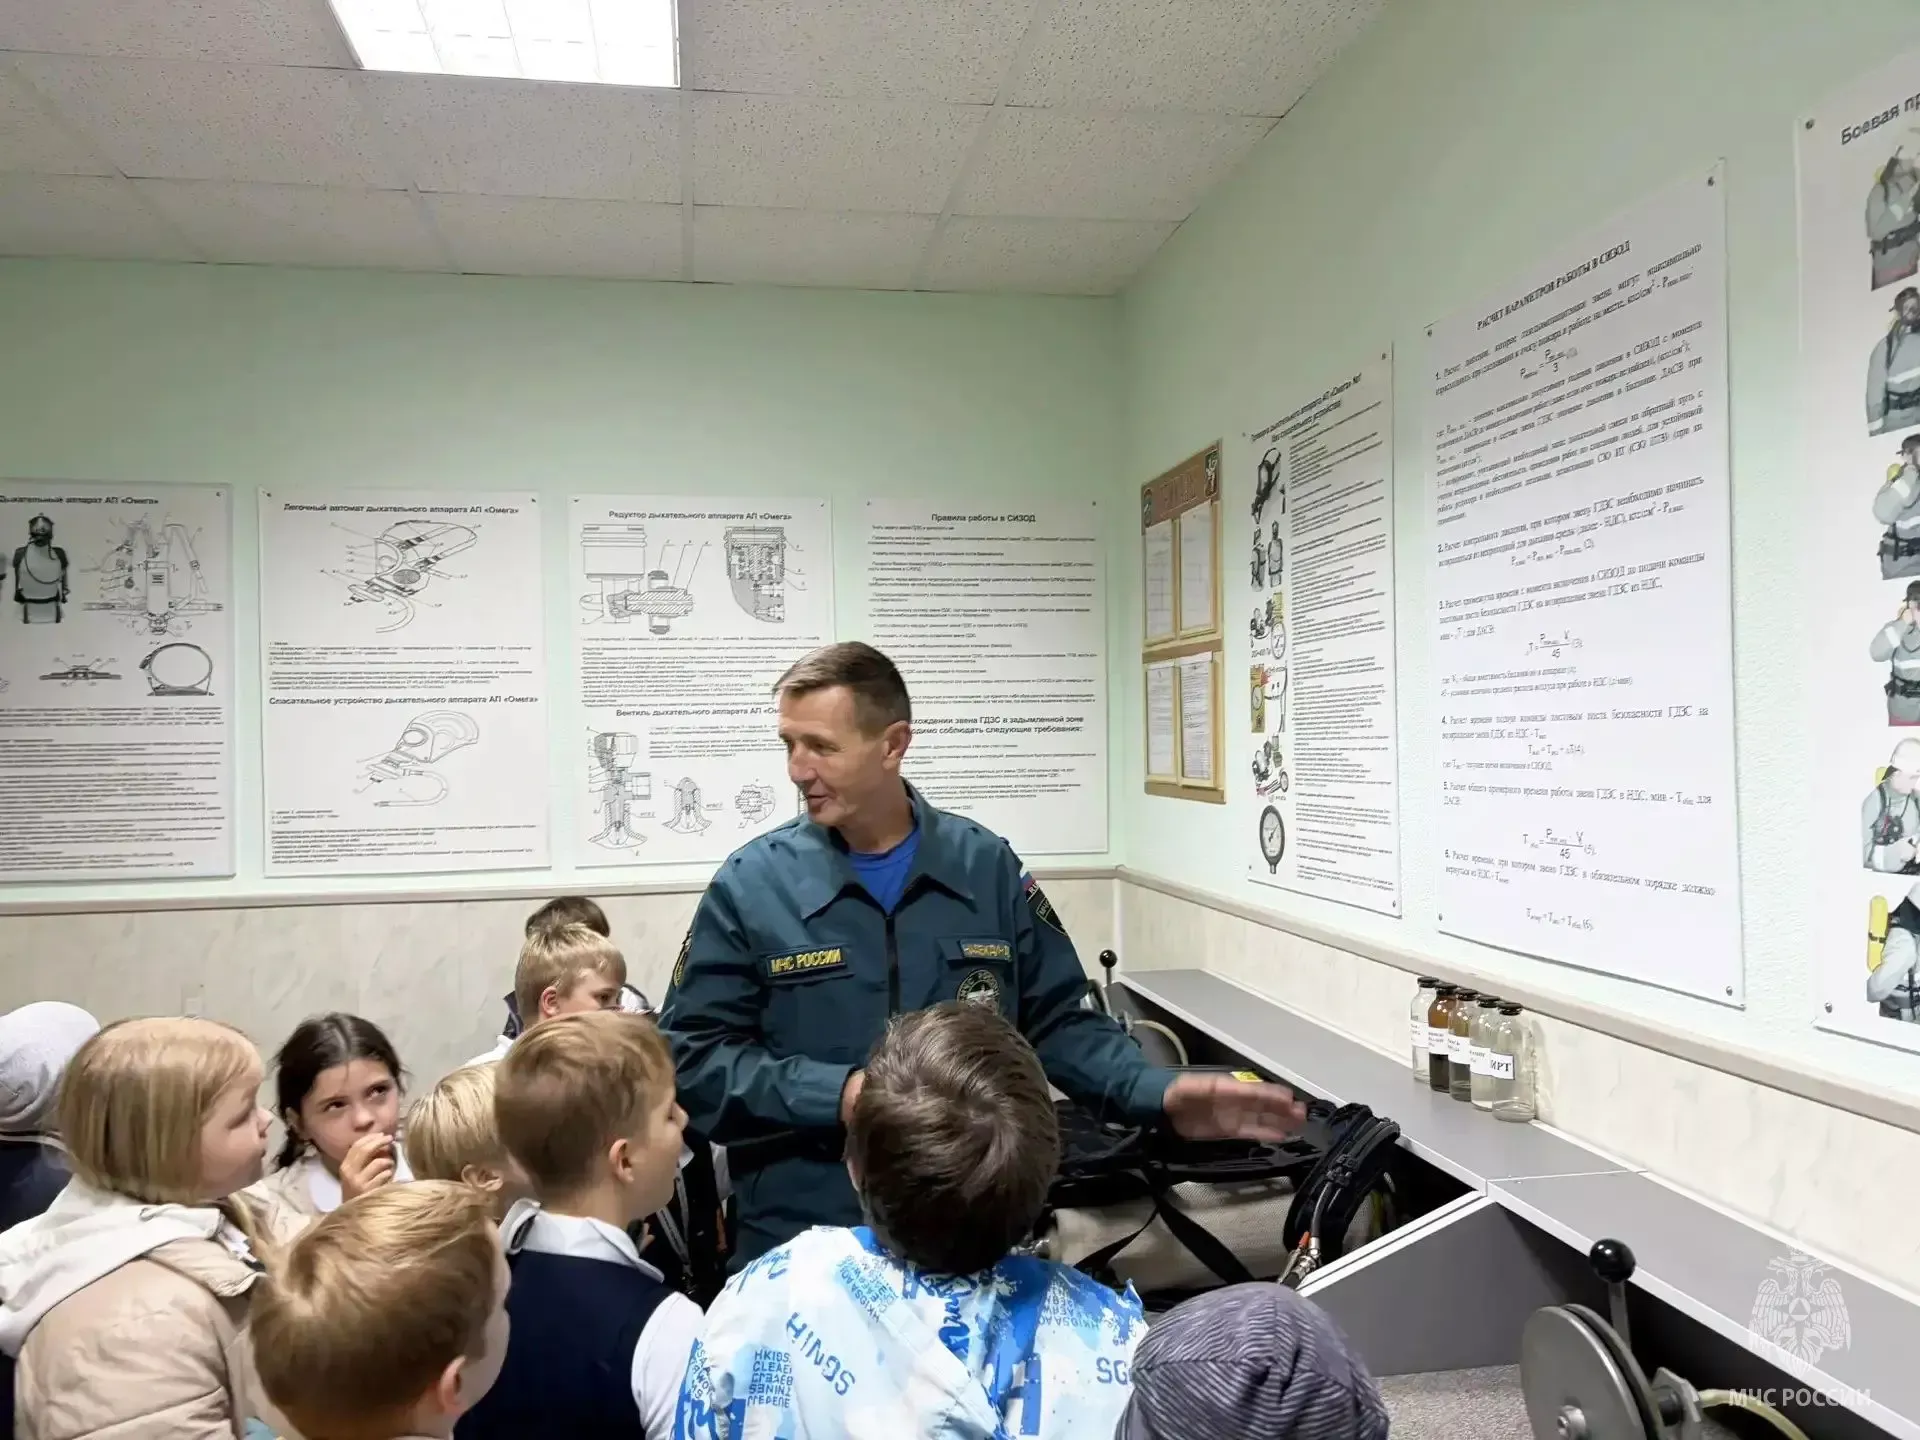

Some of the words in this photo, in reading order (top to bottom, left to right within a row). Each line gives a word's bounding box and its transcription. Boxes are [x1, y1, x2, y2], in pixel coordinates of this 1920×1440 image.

[1841, 104, 1900, 145] Боевая
[366, 505, 427, 513] дыхательного
[430, 506, 468, 514] аппарата
[484, 506, 519, 514] «Омега»
[609, 510, 646, 519] Редуктор
[648, 512, 706, 520] дыхательного
[708, 512, 744, 520] аппарата
[745, 512, 757, 520] АП
[759, 512, 792, 520] «Омега»
[931, 514, 966, 522] Правила
[968, 514, 998, 523] работы
[1007, 514, 1036, 523] СИЗОД
[269, 696, 331, 706] Спасательное
[333, 696, 382, 706] устройство
[384, 696, 446, 705] дыхательного
[448, 696, 487, 704] аппарата
[616, 709, 650, 717] Вентиль
[652, 708, 710, 717] дыхательного
[712, 708, 748, 716] аппарата
[911, 716, 954, 725] хождении
[980, 716, 1000, 725] ГДЗС
[1009, 715, 1064, 724] задымленной
[939, 726, 984, 734] соблюдать
[985, 726, 1032, 734] следующие
[1033, 726, 1083, 734] требования:
[771, 956, 794, 973] МЧС
[796, 948, 842, 969] РОССИИ
